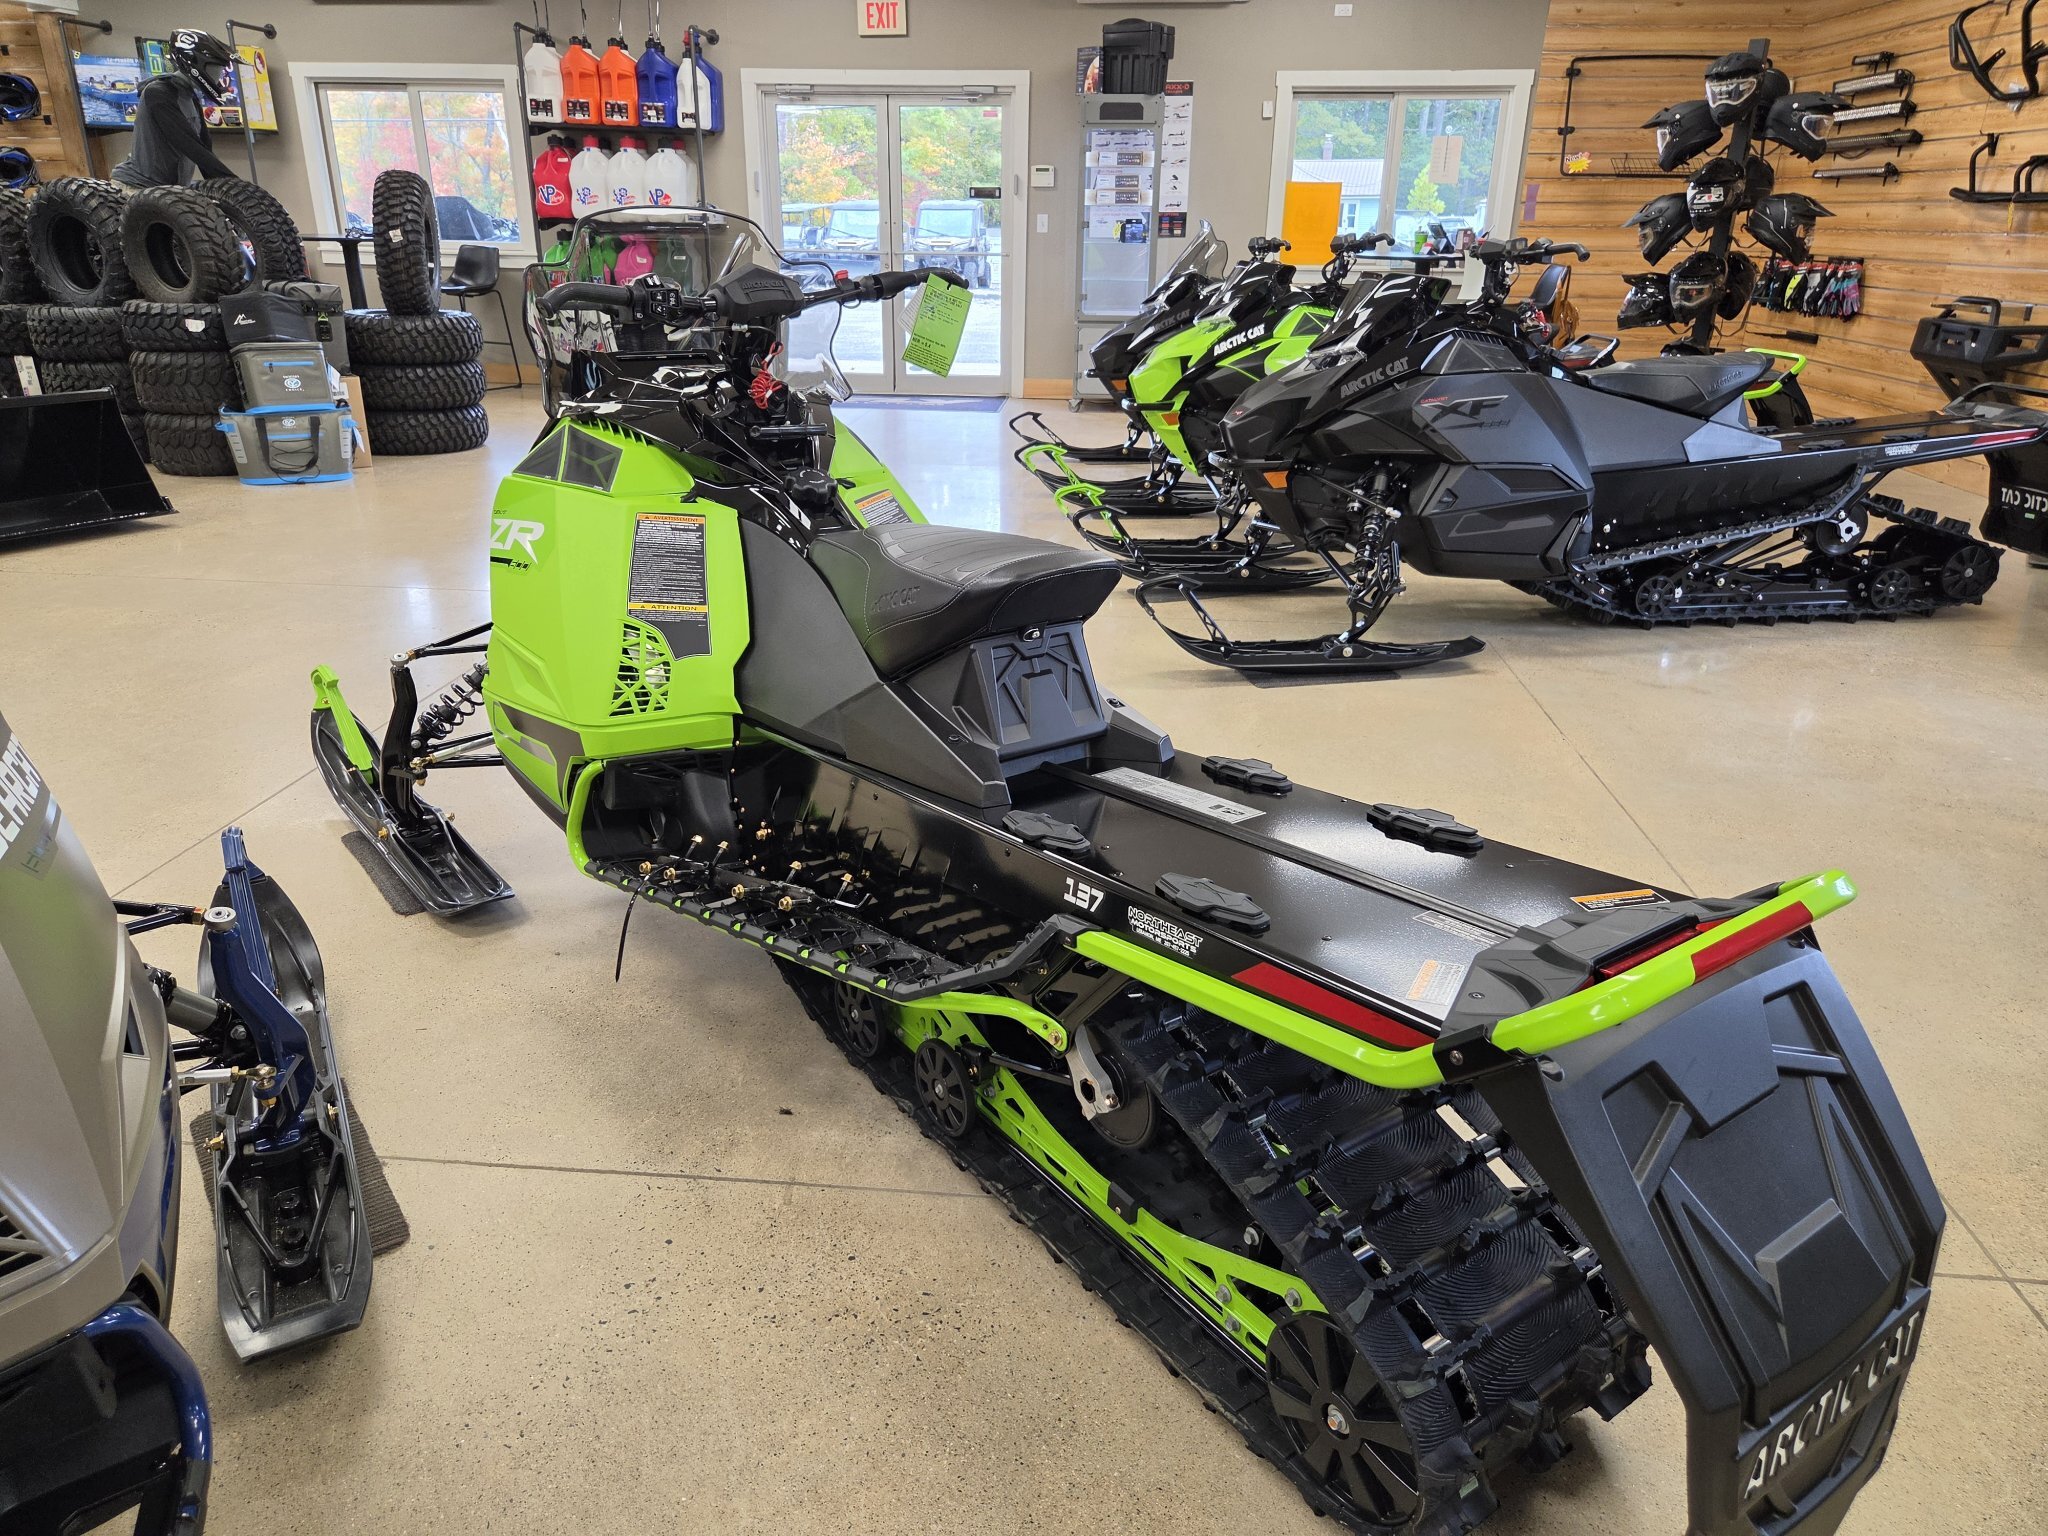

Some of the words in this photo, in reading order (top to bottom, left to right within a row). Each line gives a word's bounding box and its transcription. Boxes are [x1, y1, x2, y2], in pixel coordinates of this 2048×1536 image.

[866, 2, 898, 29] EXIT
[1166, 83, 1190, 91] AXX-D
[539, 184, 556, 204] VP
[649, 188, 664, 207] VP
[771, 279, 786, 288] CAT
[1176, 309, 1191, 321] CAT
[1213, 333, 1248, 357] ARCTIC
[1246, 324, 1266, 341] CAT
[1340, 366, 1385, 399] ARCTIC
[1386, 357, 1410, 377] CAT
[653, 514, 699, 523] AVERTISSEMENT
[490, 518, 545, 566] ZR
[651, 604, 698, 612] ATTENTION
[1063, 876, 1104, 912] 137
[1128, 905, 1203, 949] NORTHEAST
[1130, 917, 1197, 953] MOTORSPORTS
[1743, 1363, 1862, 1500] ARCTIC
[1867, 1310, 1920, 1391] CAT
